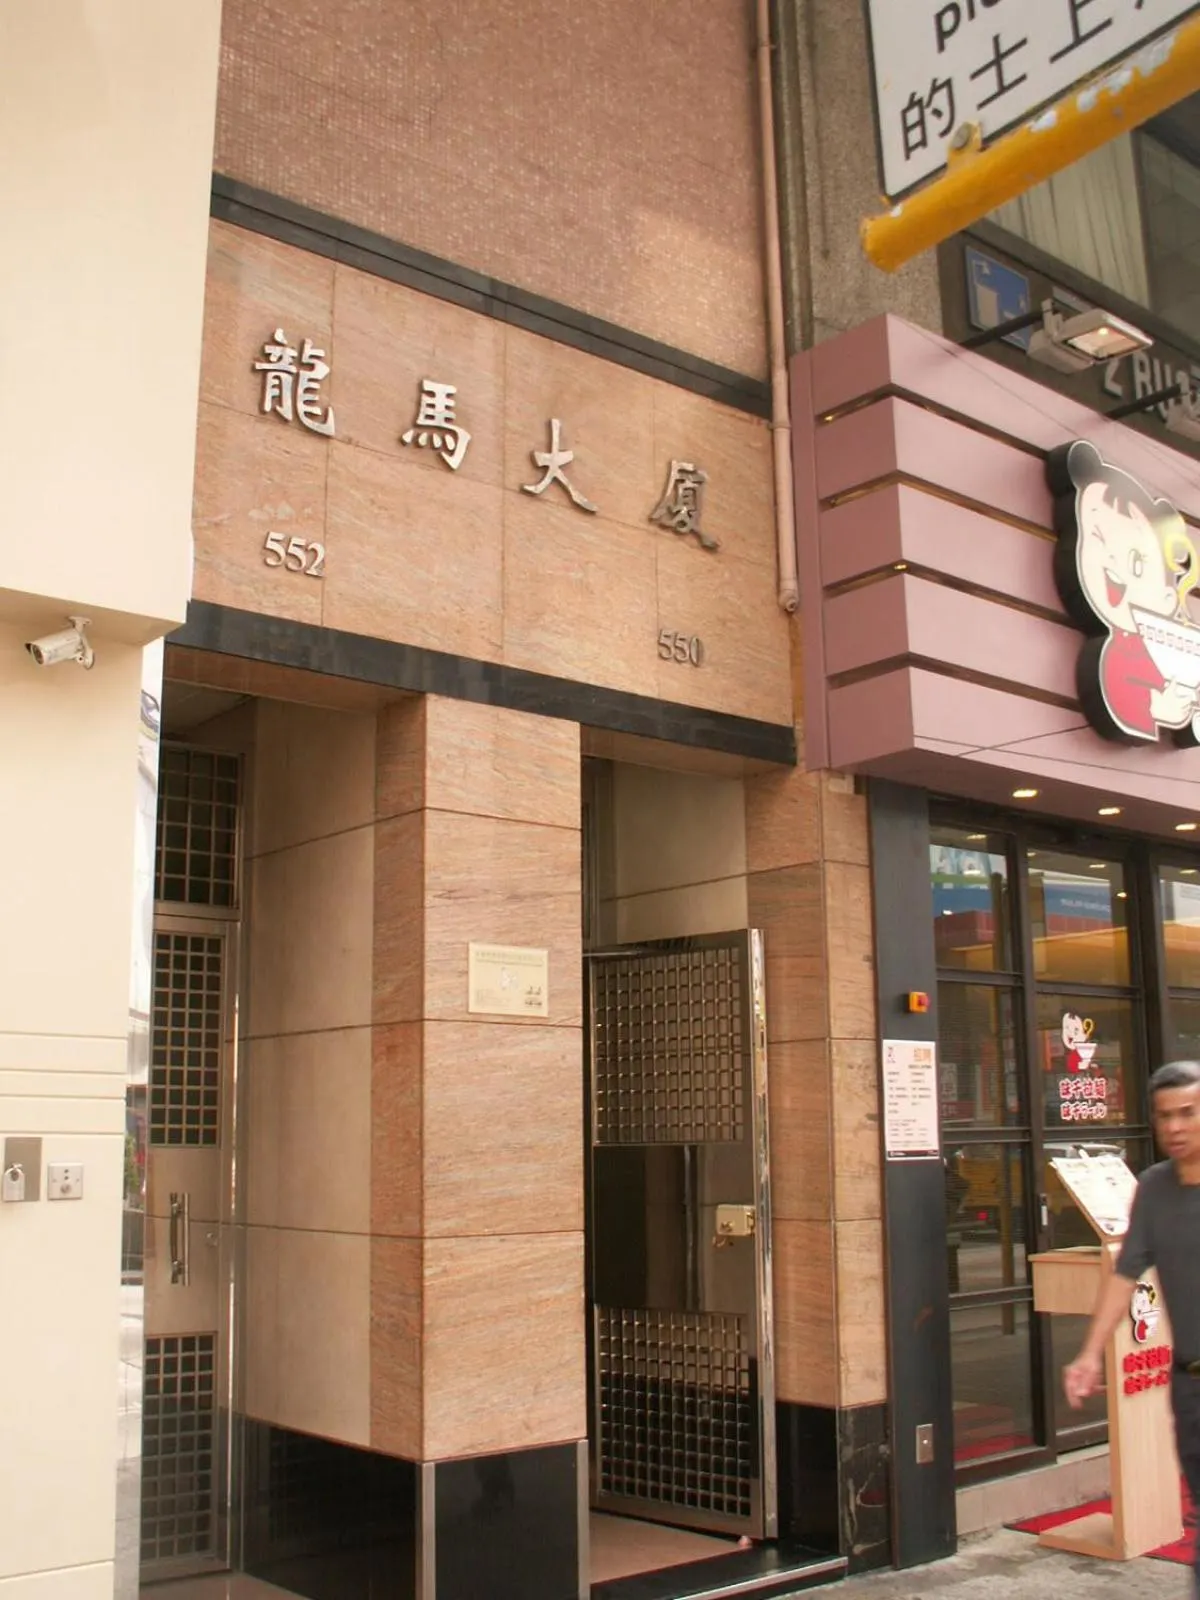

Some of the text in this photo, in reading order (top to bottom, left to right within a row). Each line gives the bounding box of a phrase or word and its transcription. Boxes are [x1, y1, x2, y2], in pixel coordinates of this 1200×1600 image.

[901, 0, 1145, 161] 的士上
[263, 530, 325, 577] 552
[657, 628, 705, 668] 550
